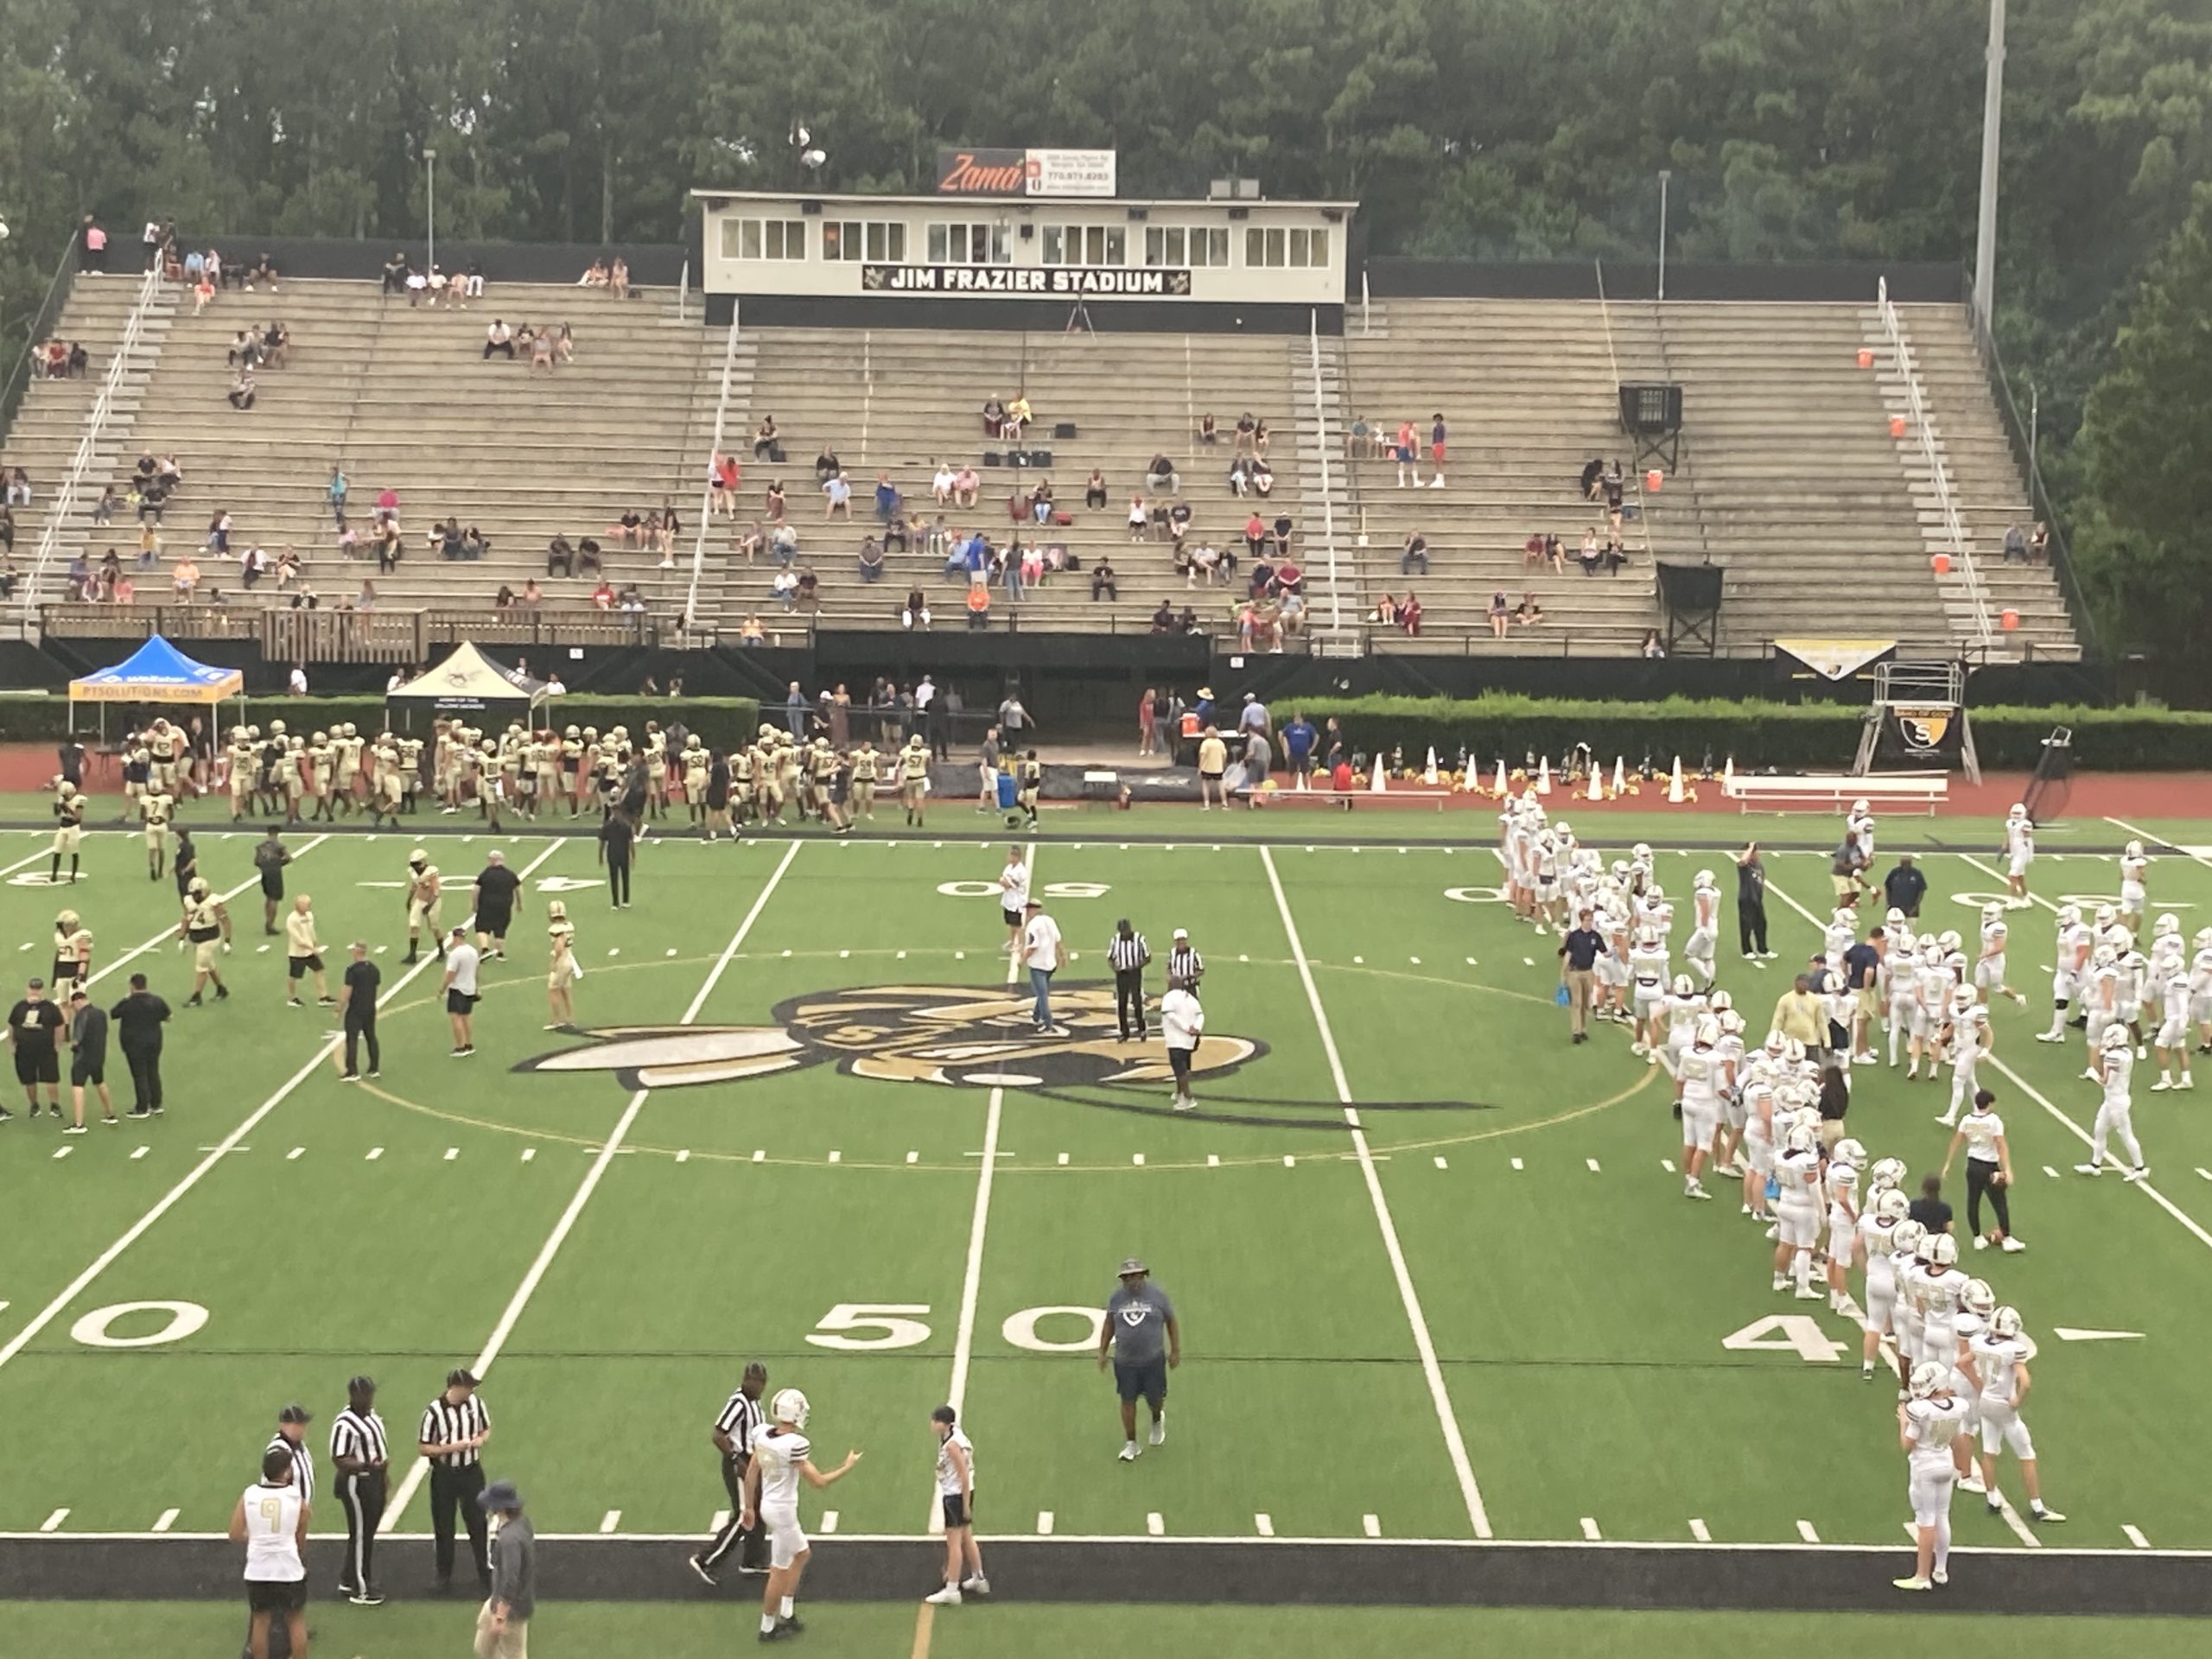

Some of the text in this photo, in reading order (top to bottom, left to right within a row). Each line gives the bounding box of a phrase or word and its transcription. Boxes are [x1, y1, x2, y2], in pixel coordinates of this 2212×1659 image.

[939, 153, 1022, 191] Zama
[891, 268, 1164, 293] JIM FRAZIER STADIUM
[1915, 724, 1931, 741] S
[150, 800, 159, 816] 7
[71, 1300, 209, 1346] 0
[804, 1303, 1116, 1351] 5 0
[1721, 1314, 1850, 1362] 4
[261, 1497, 282, 1534] 9
